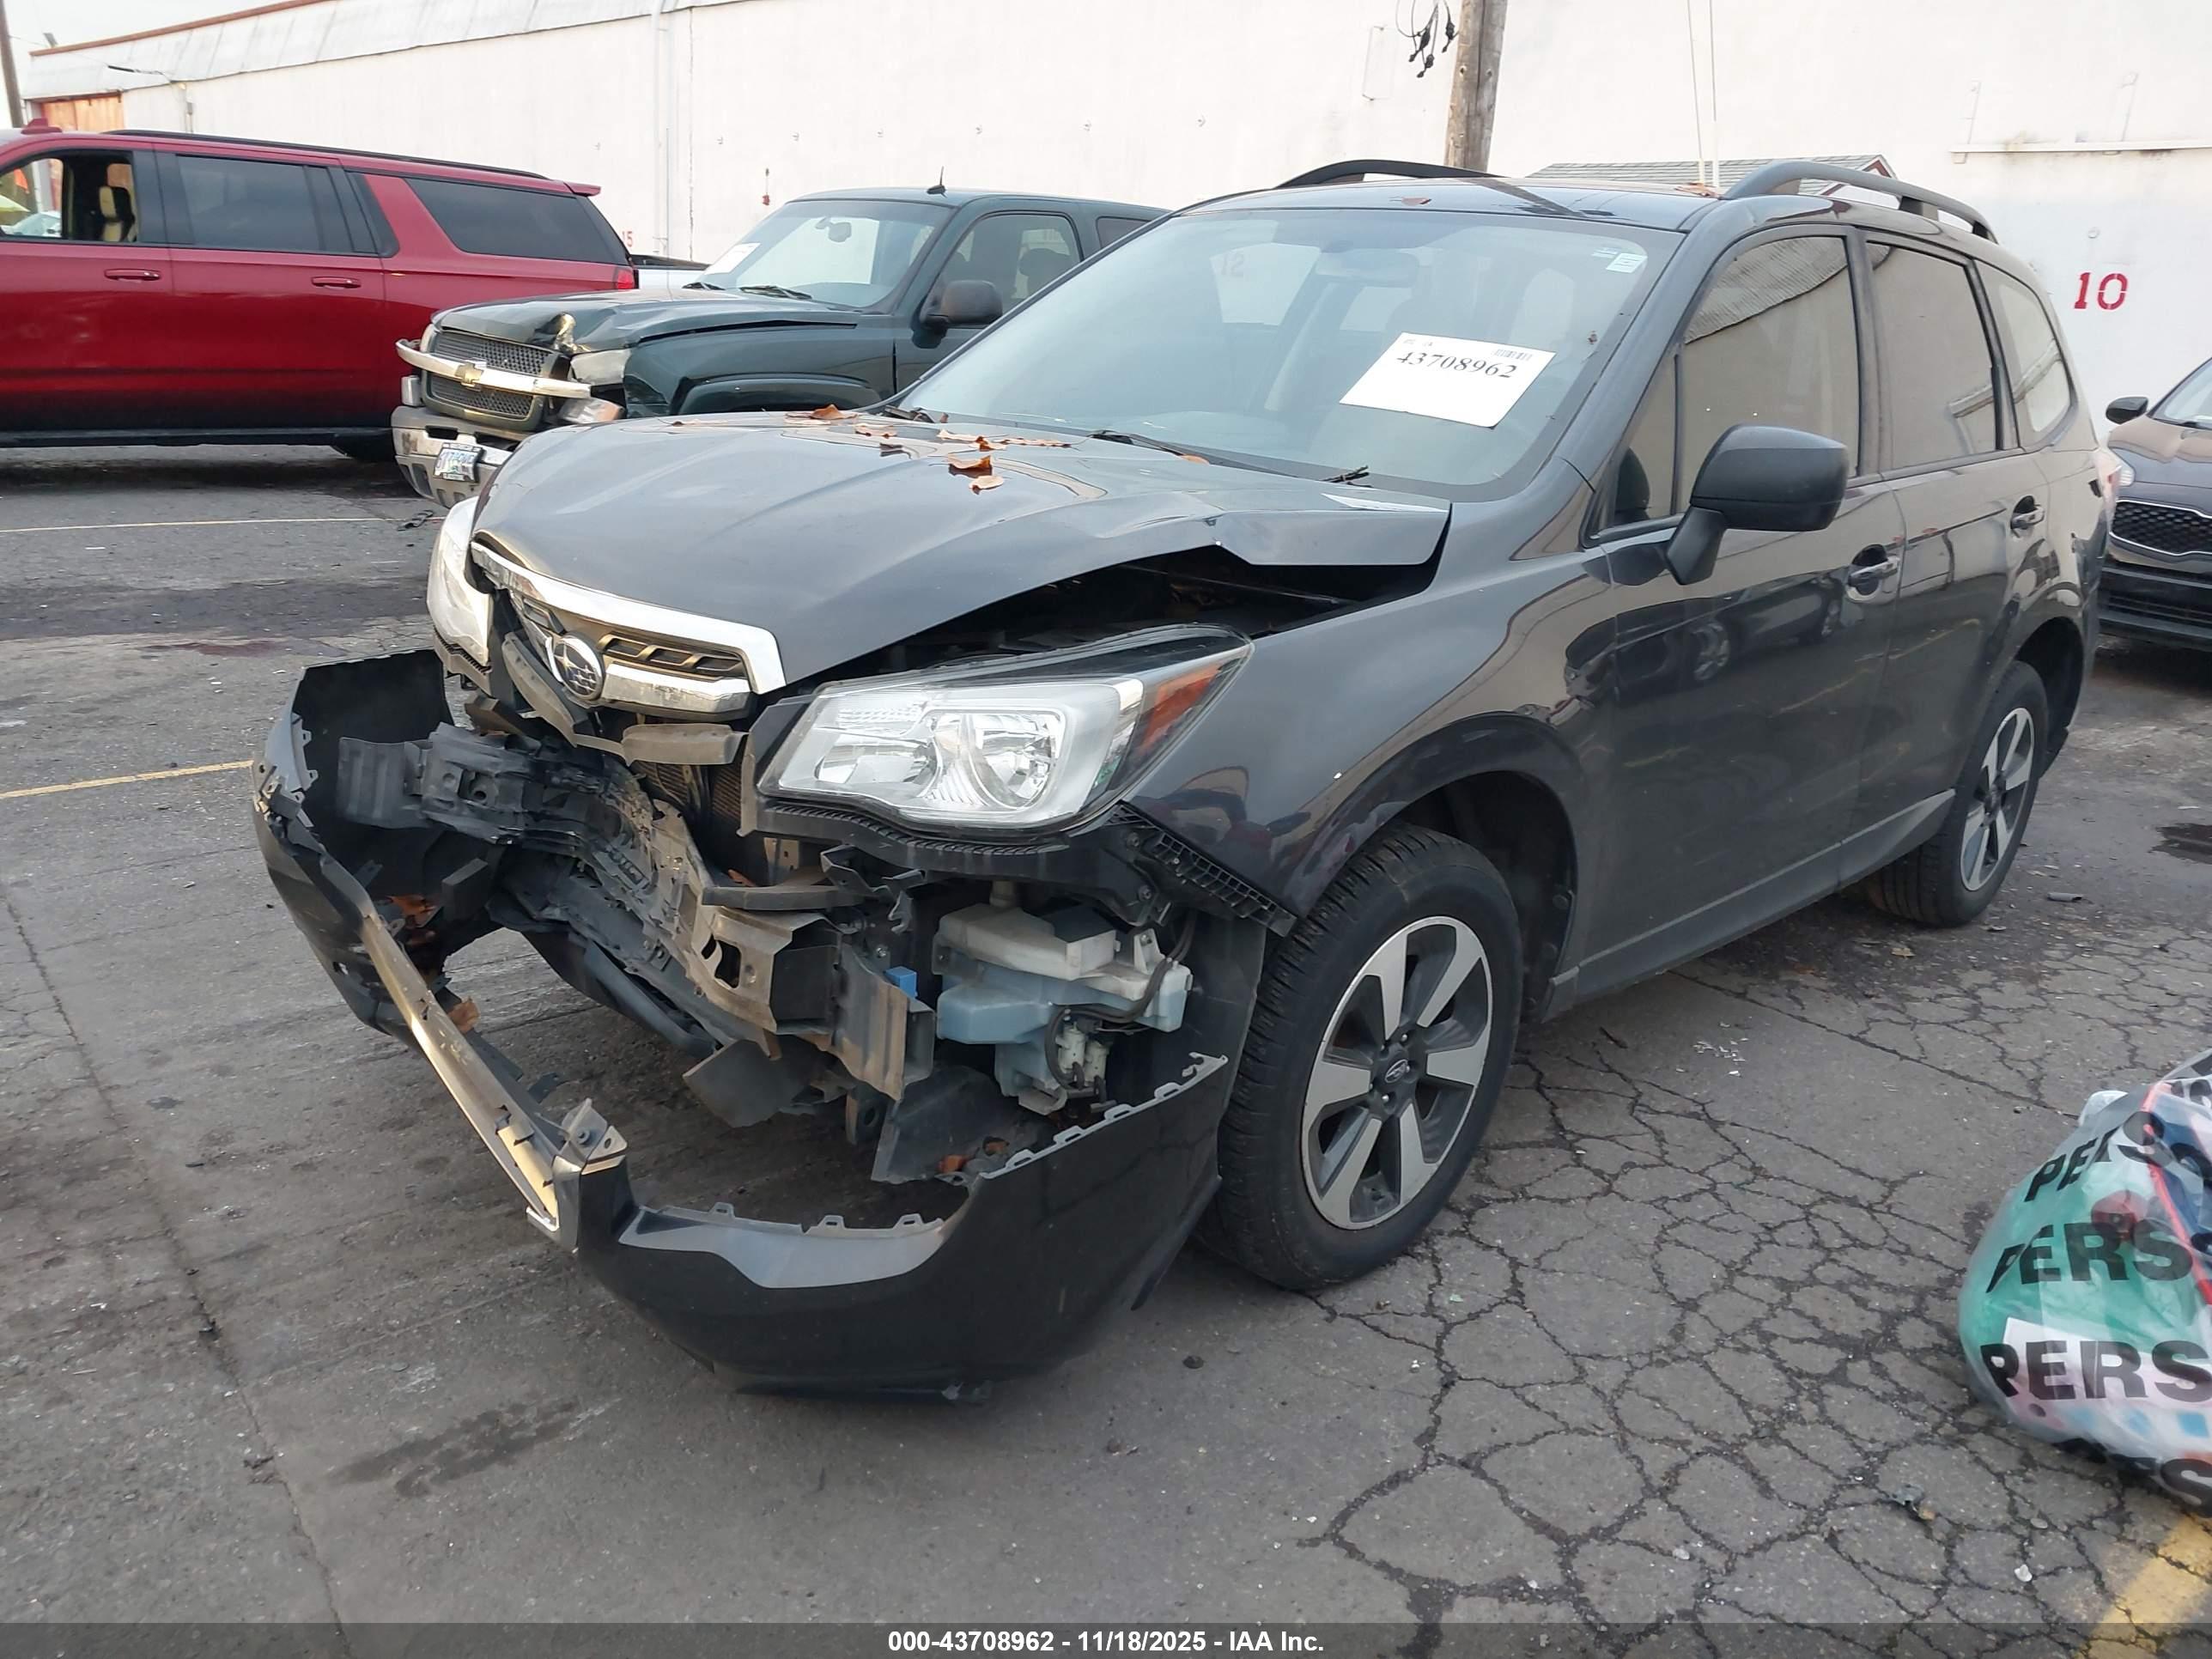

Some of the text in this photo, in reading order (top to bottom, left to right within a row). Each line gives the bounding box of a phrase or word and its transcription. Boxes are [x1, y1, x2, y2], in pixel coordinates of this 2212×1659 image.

[2074, 272, 2128, 310] 10
[1396, 350, 1517, 378] 43708962
[1980, 1340, 2212, 1403] PERS
